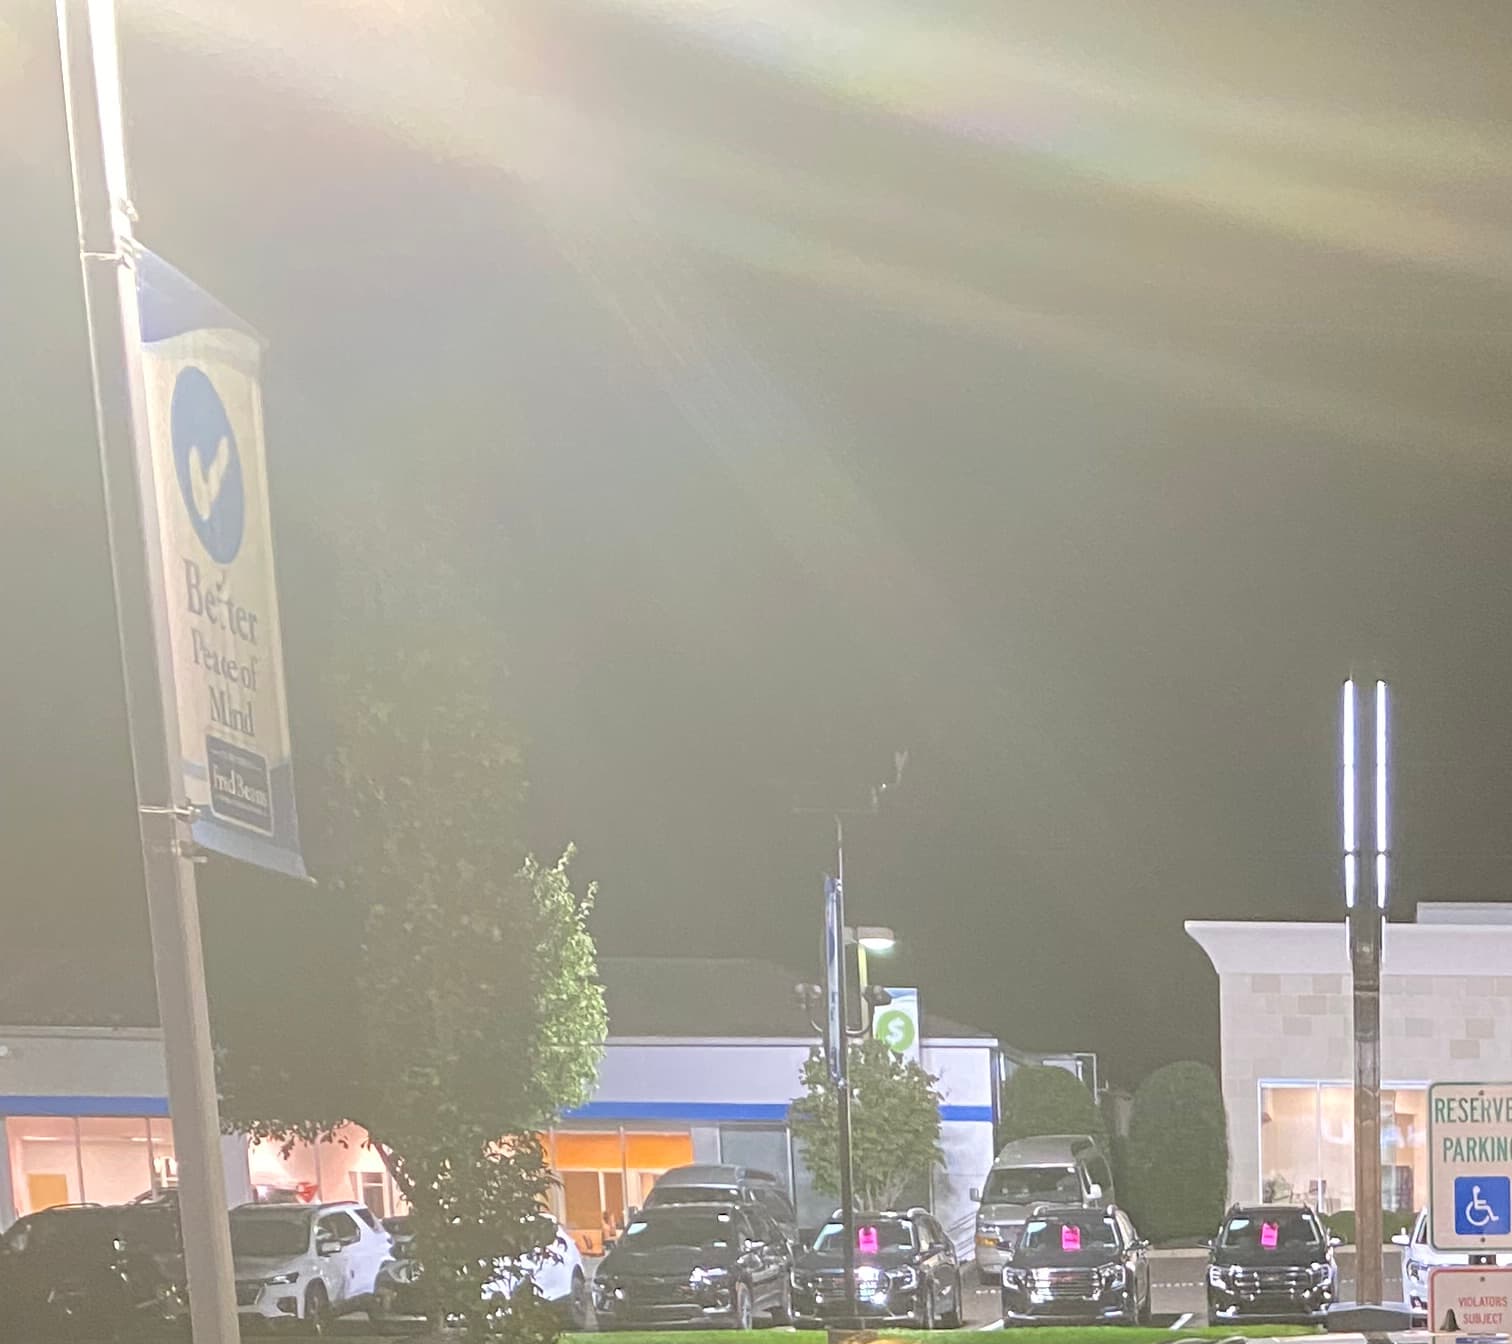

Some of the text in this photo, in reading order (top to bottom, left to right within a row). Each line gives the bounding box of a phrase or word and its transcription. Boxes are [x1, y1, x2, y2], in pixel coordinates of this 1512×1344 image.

[183, 558, 257, 645] Better
[241, 656, 257, 692] of
[208, 685, 255, 737] Mind
[1457, 1295, 1509, 1308] VIOLATORS
[1462, 1312, 1504, 1325] SUBJECT
